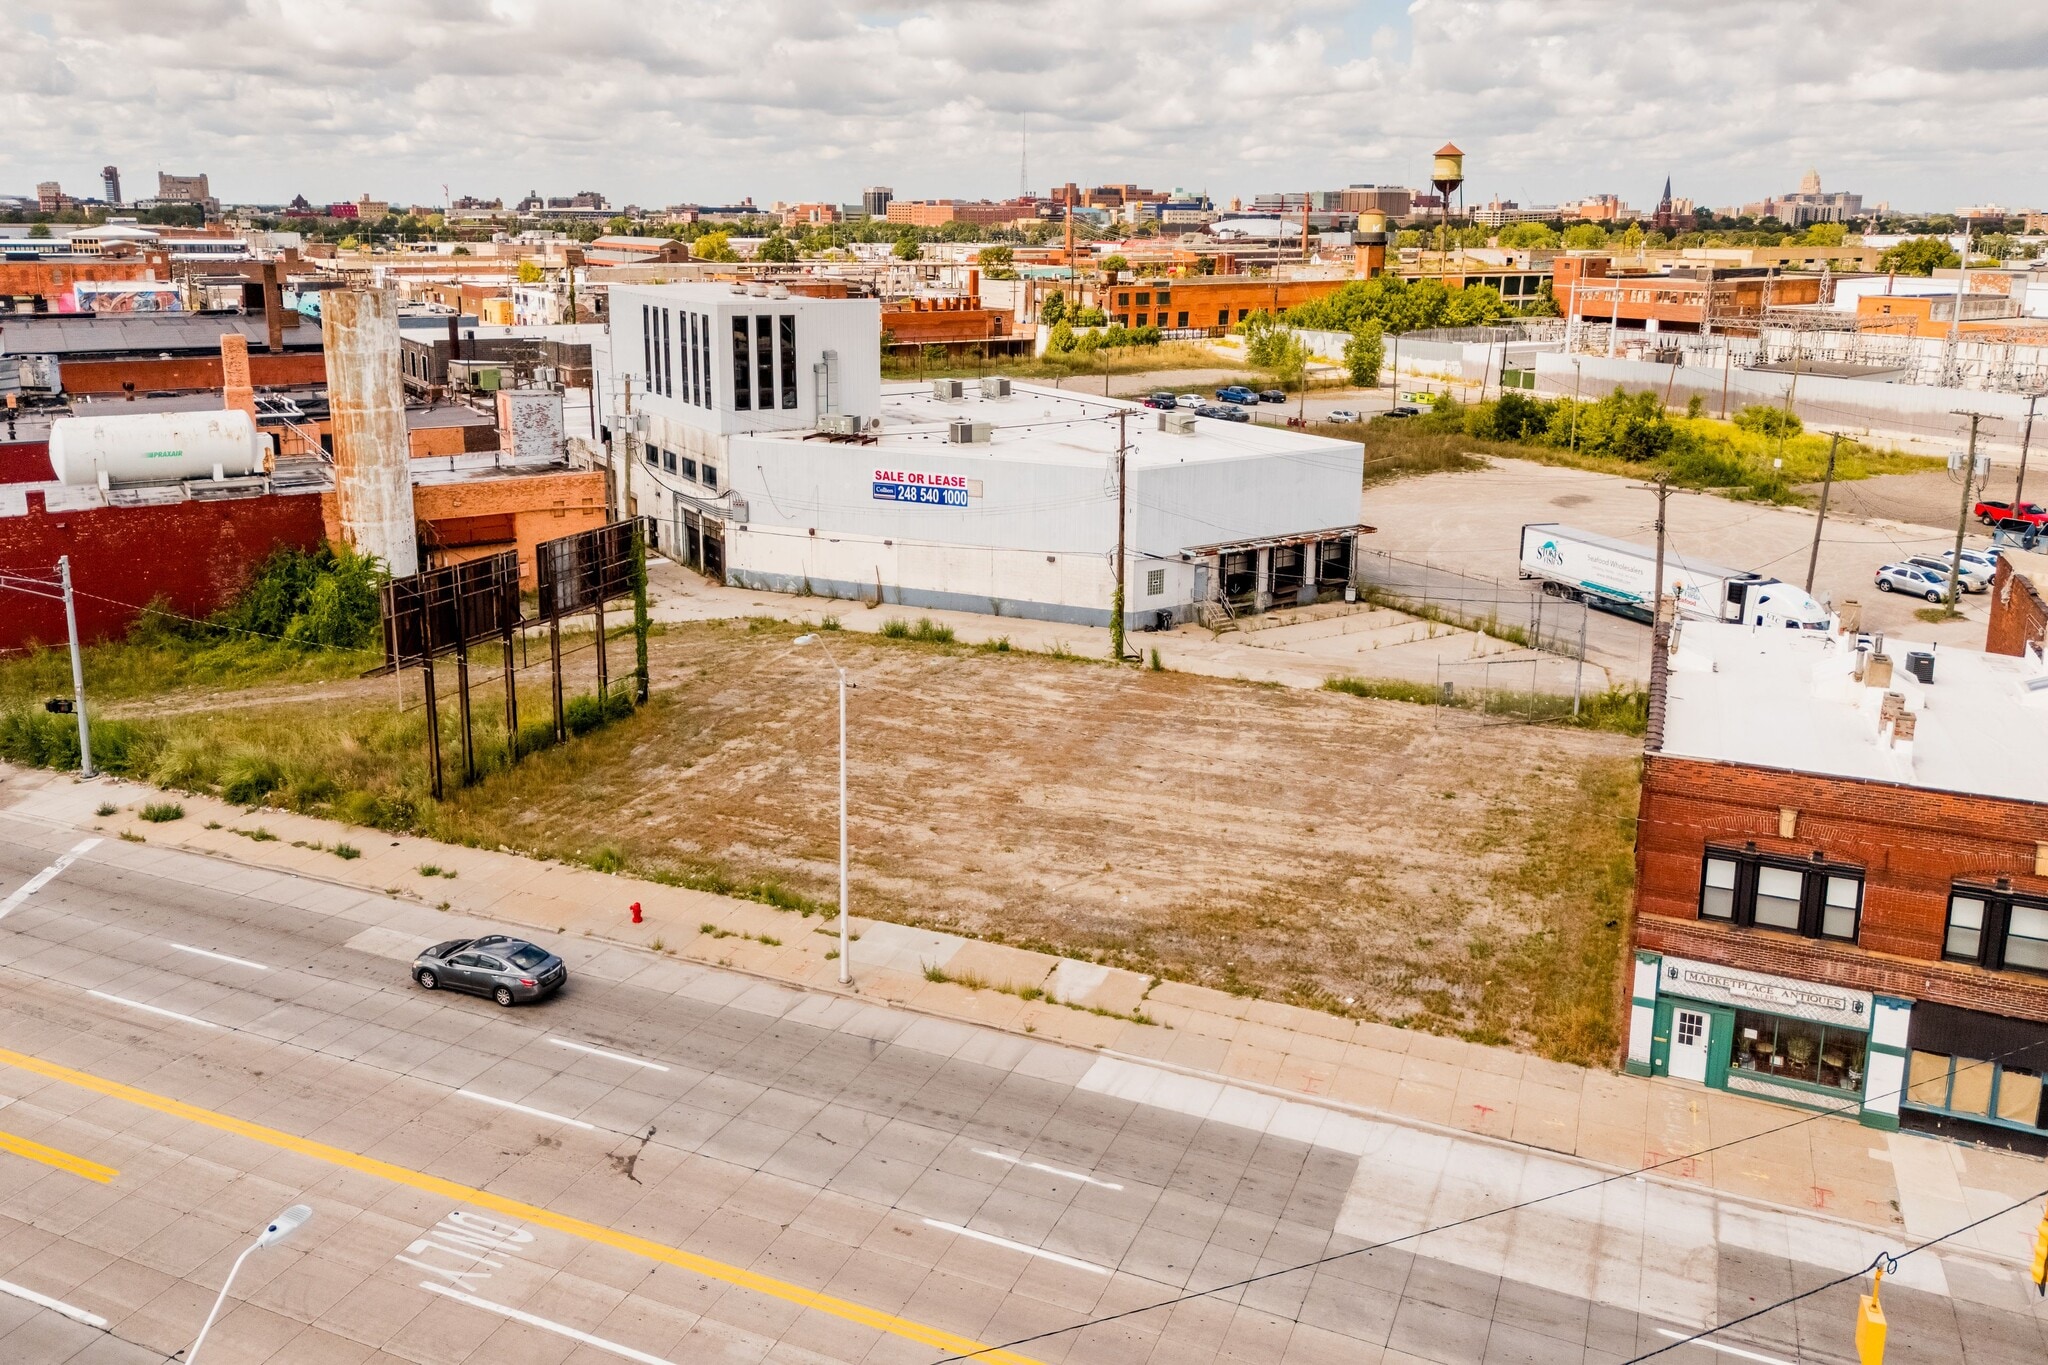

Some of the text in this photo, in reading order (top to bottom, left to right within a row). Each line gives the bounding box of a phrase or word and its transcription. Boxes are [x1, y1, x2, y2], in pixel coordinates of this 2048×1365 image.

[153, 450, 183, 458] PRAXAIR
[875, 471, 966, 487] SALE OR LEASE
[898, 486, 967, 505] 248 540 1000
[1587, 554, 1610, 566] Seafood
[1610, 559, 1644, 576] Wholesalers
[1689, 973, 1842, 1008] MARKETPLACE ANTIQUES
[1747, 991, 1779, 1001] GALLERY
[394, 1211, 534, 1292] ONLY
